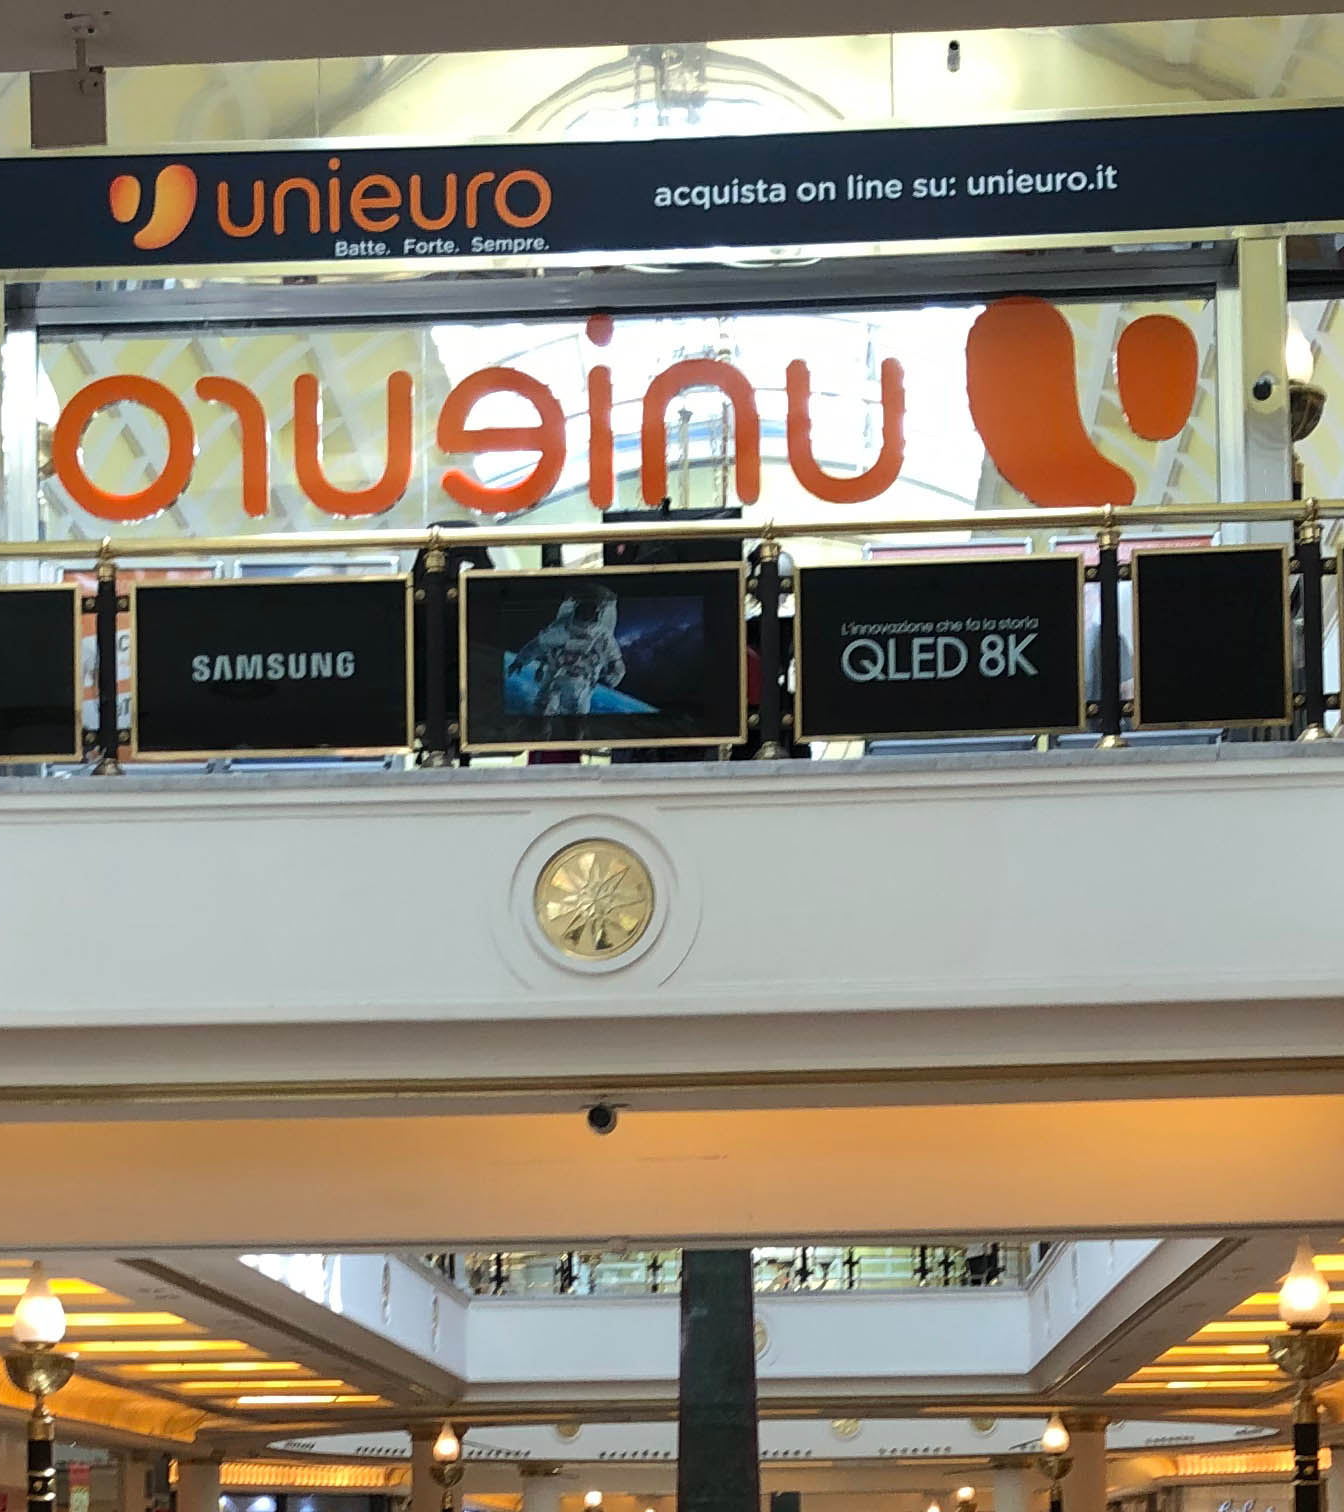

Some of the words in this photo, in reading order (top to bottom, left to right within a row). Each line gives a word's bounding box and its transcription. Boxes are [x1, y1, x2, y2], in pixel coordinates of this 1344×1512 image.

[217, 156, 553, 238] unieuro
[654, 177, 787, 210] acquista
[796, 180, 837, 202] on
[846, 174, 904, 201] line
[912, 176, 957, 199] su:
[966, 164, 1119, 196] unieuro.it
[334, 239, 391, 257] Batte.
[403, 237, 460, 256] Forte.
[471, 235, 551, 254] Sempre.
[840, 619, 934, 637] L'innovazione
[935, 618, 963, 633] che
[997, 615, 1040, 630] storia
[191, 650, 356, 683] SAMSUNG
[840, 635, 969, 683] QLED
[979, 632, 1040, 678] 8K
